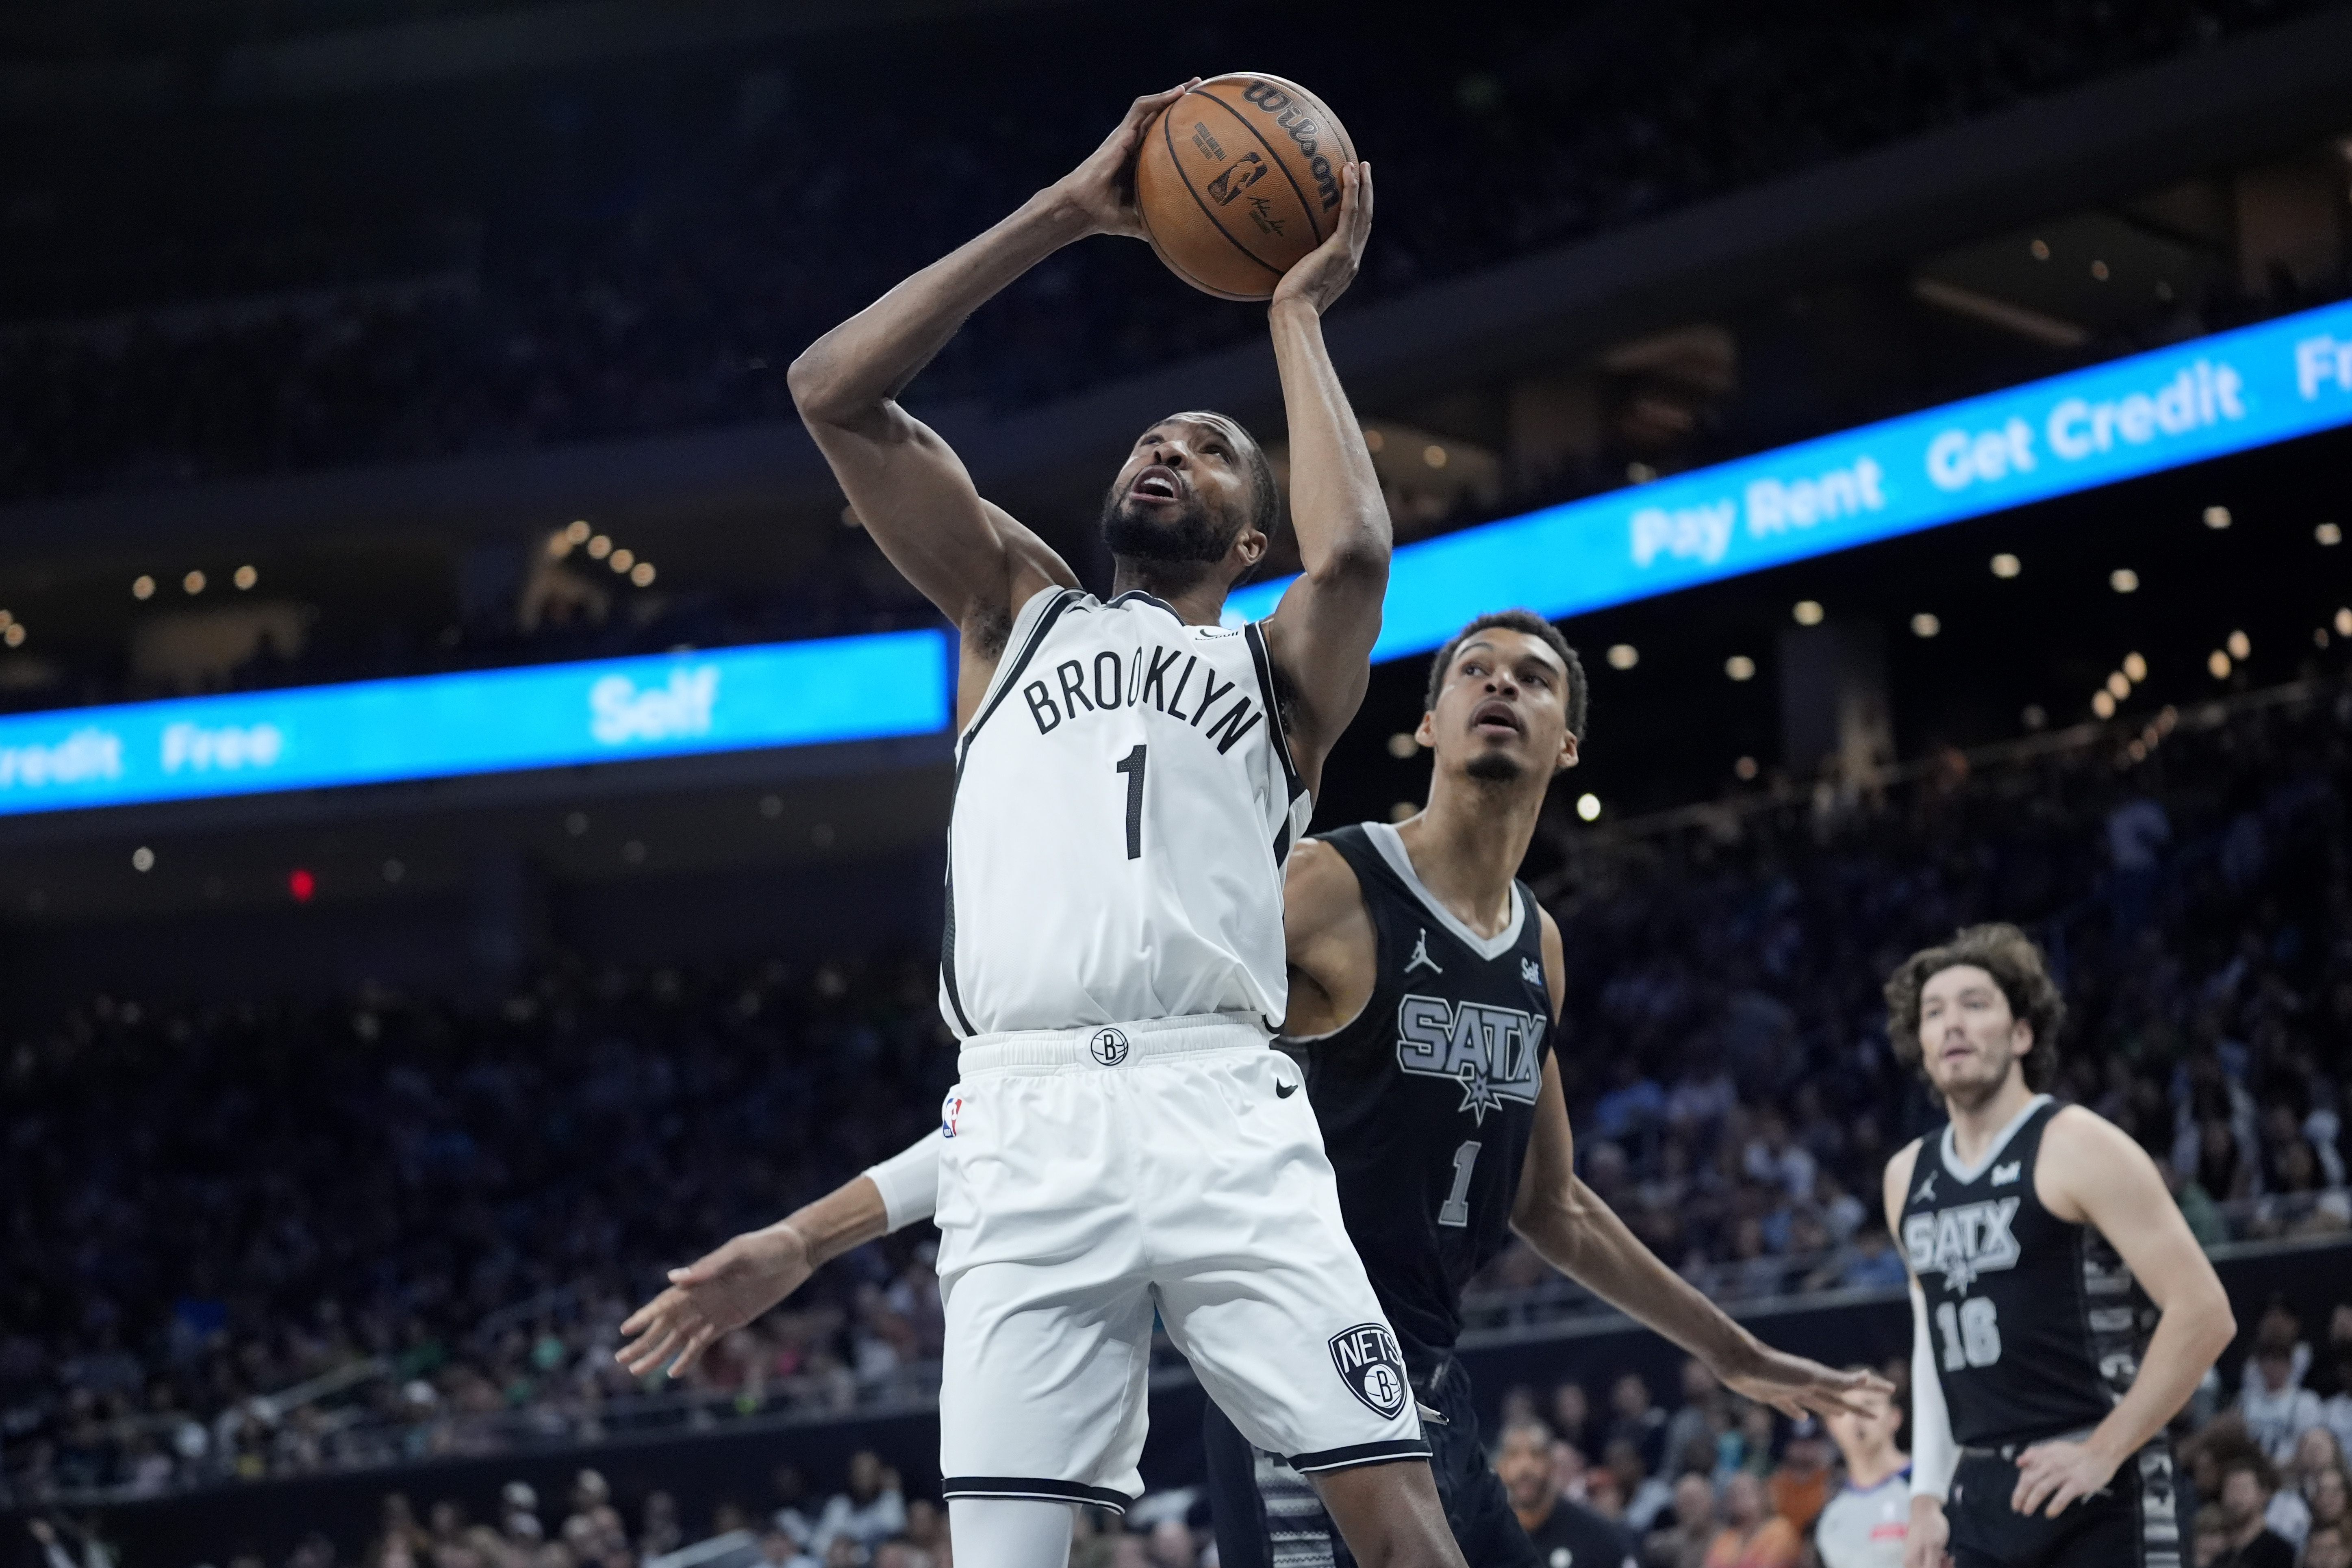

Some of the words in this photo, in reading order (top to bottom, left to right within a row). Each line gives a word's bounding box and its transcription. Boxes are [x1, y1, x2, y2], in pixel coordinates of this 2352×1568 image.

[1242, 80, 1341, 214] Wilson
[1631, 505, 1735, 568] Pay
[1746, 455, 1885, 539] Rent
[1927, 417, 2035, 490] Get
[2047, 359, 2245, 461] Credit
[589, 666, 719, 743] Self
[1023, 645, 1263, 755] BROOKLYN
[163, 723, 280, 773] Free
[1116, 744, 1147, 860] 1
[1397, 994, 1547, 1105] SATX
[1438, 1140, 1482, 1227] 1
[1904, 1196, 2022, 1275] SATX
[1338, 1329, 1401, 1373] NETS
[1377, 1370, 1393, 1403] B
